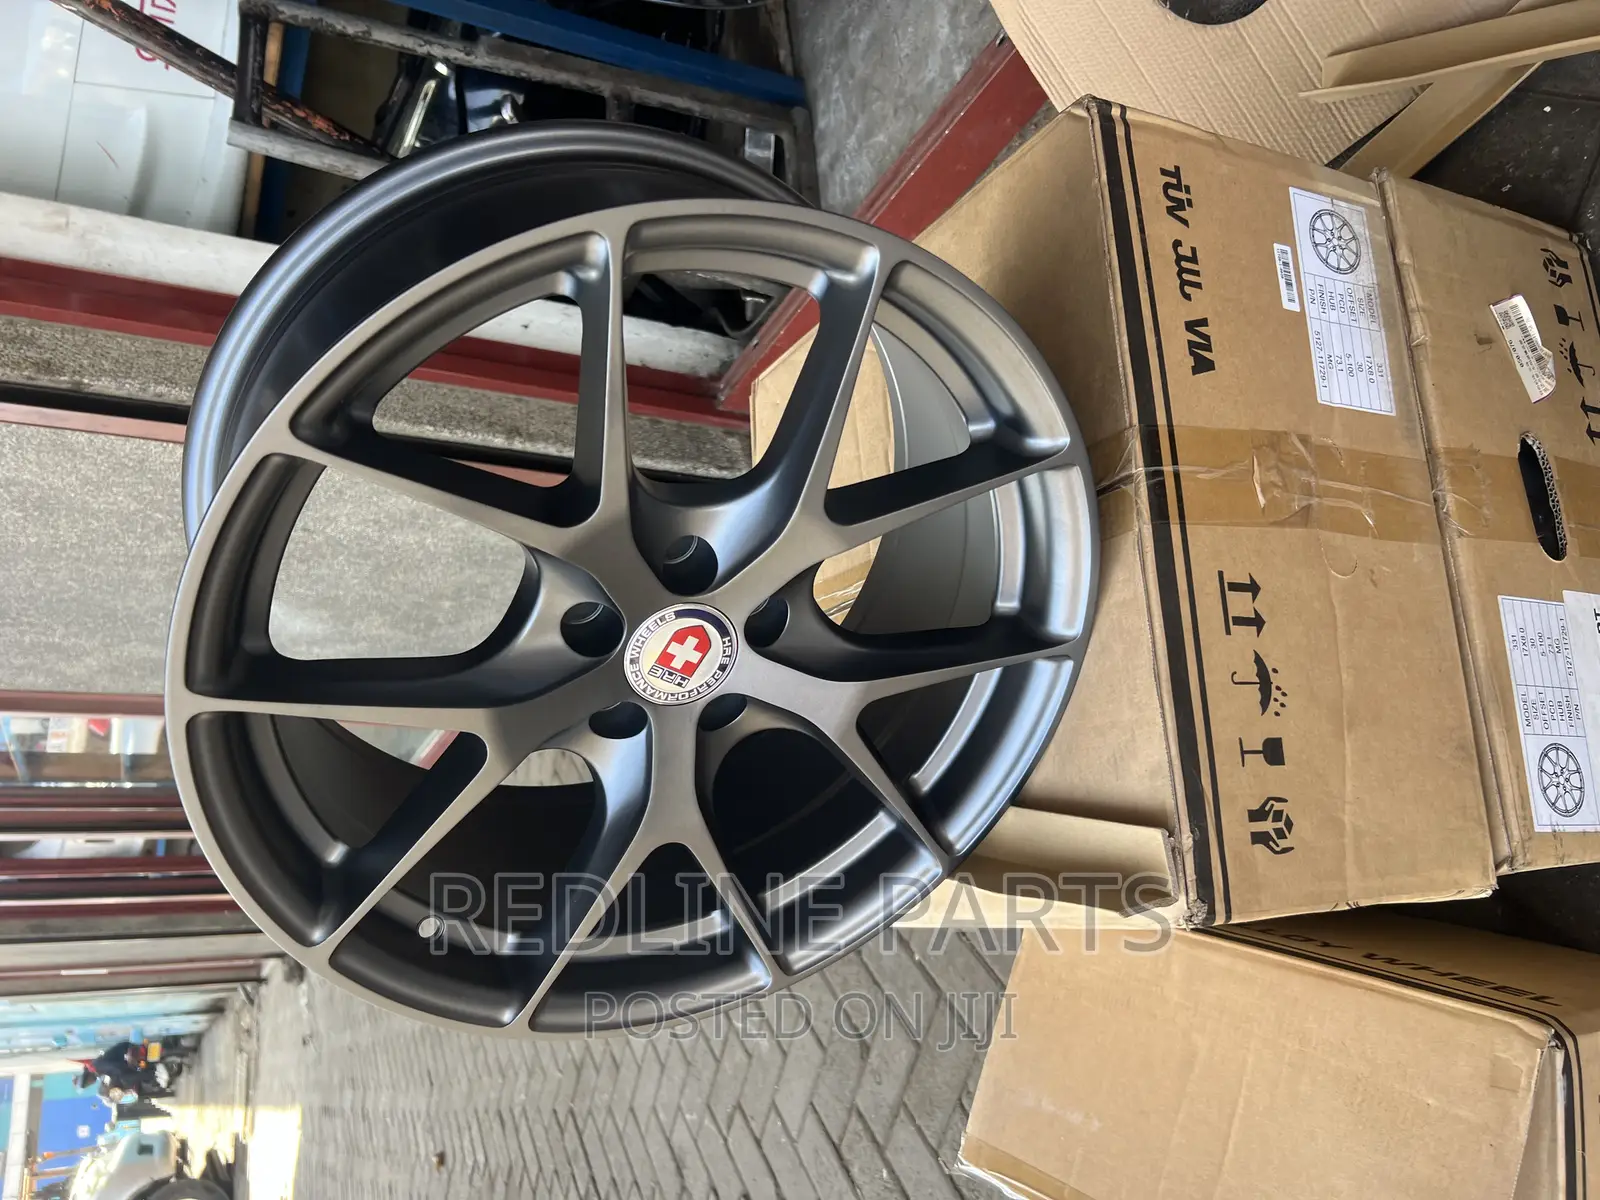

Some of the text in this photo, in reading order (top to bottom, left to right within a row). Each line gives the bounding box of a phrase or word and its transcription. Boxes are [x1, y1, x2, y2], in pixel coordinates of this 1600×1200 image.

[1159, 165, 1193, 228] TÜV
[1184, 317, 1216, 376] VIA
[1357, 297, 1365, 317] SIZE
[1308, 288, 1328, 389] P/N 5127-11729-1
[1317, 283, 1334, 370] FINISH MG
[1328, 291, 1344, 372] HUB 73.1
[1338, 293, 1354, 378] PCD 5-100
[1346, 287, 1364, 372] OFFSET 30
[1366, 292, 1385, 378] MODEL 331
[630, 611, 732, 702] HRE PERFORMANCE WHEELS
[647, 663, 691, 688] HRE
[1511, 634, 1531, 727] MODEL 331
[1530, 638, 1549, 730] OFFSET 30
[1537, 632, 1556, 721] PCD 5-100
[1554, 638, 1574, 728] FINISH MG
[1531, 698, 1539, 720] SIZE
[1557, 700, 1565, 721] HUB
[1573, 703, 1581, 720] P/N
[1361, 952, 1562, 1007] WHEEL
